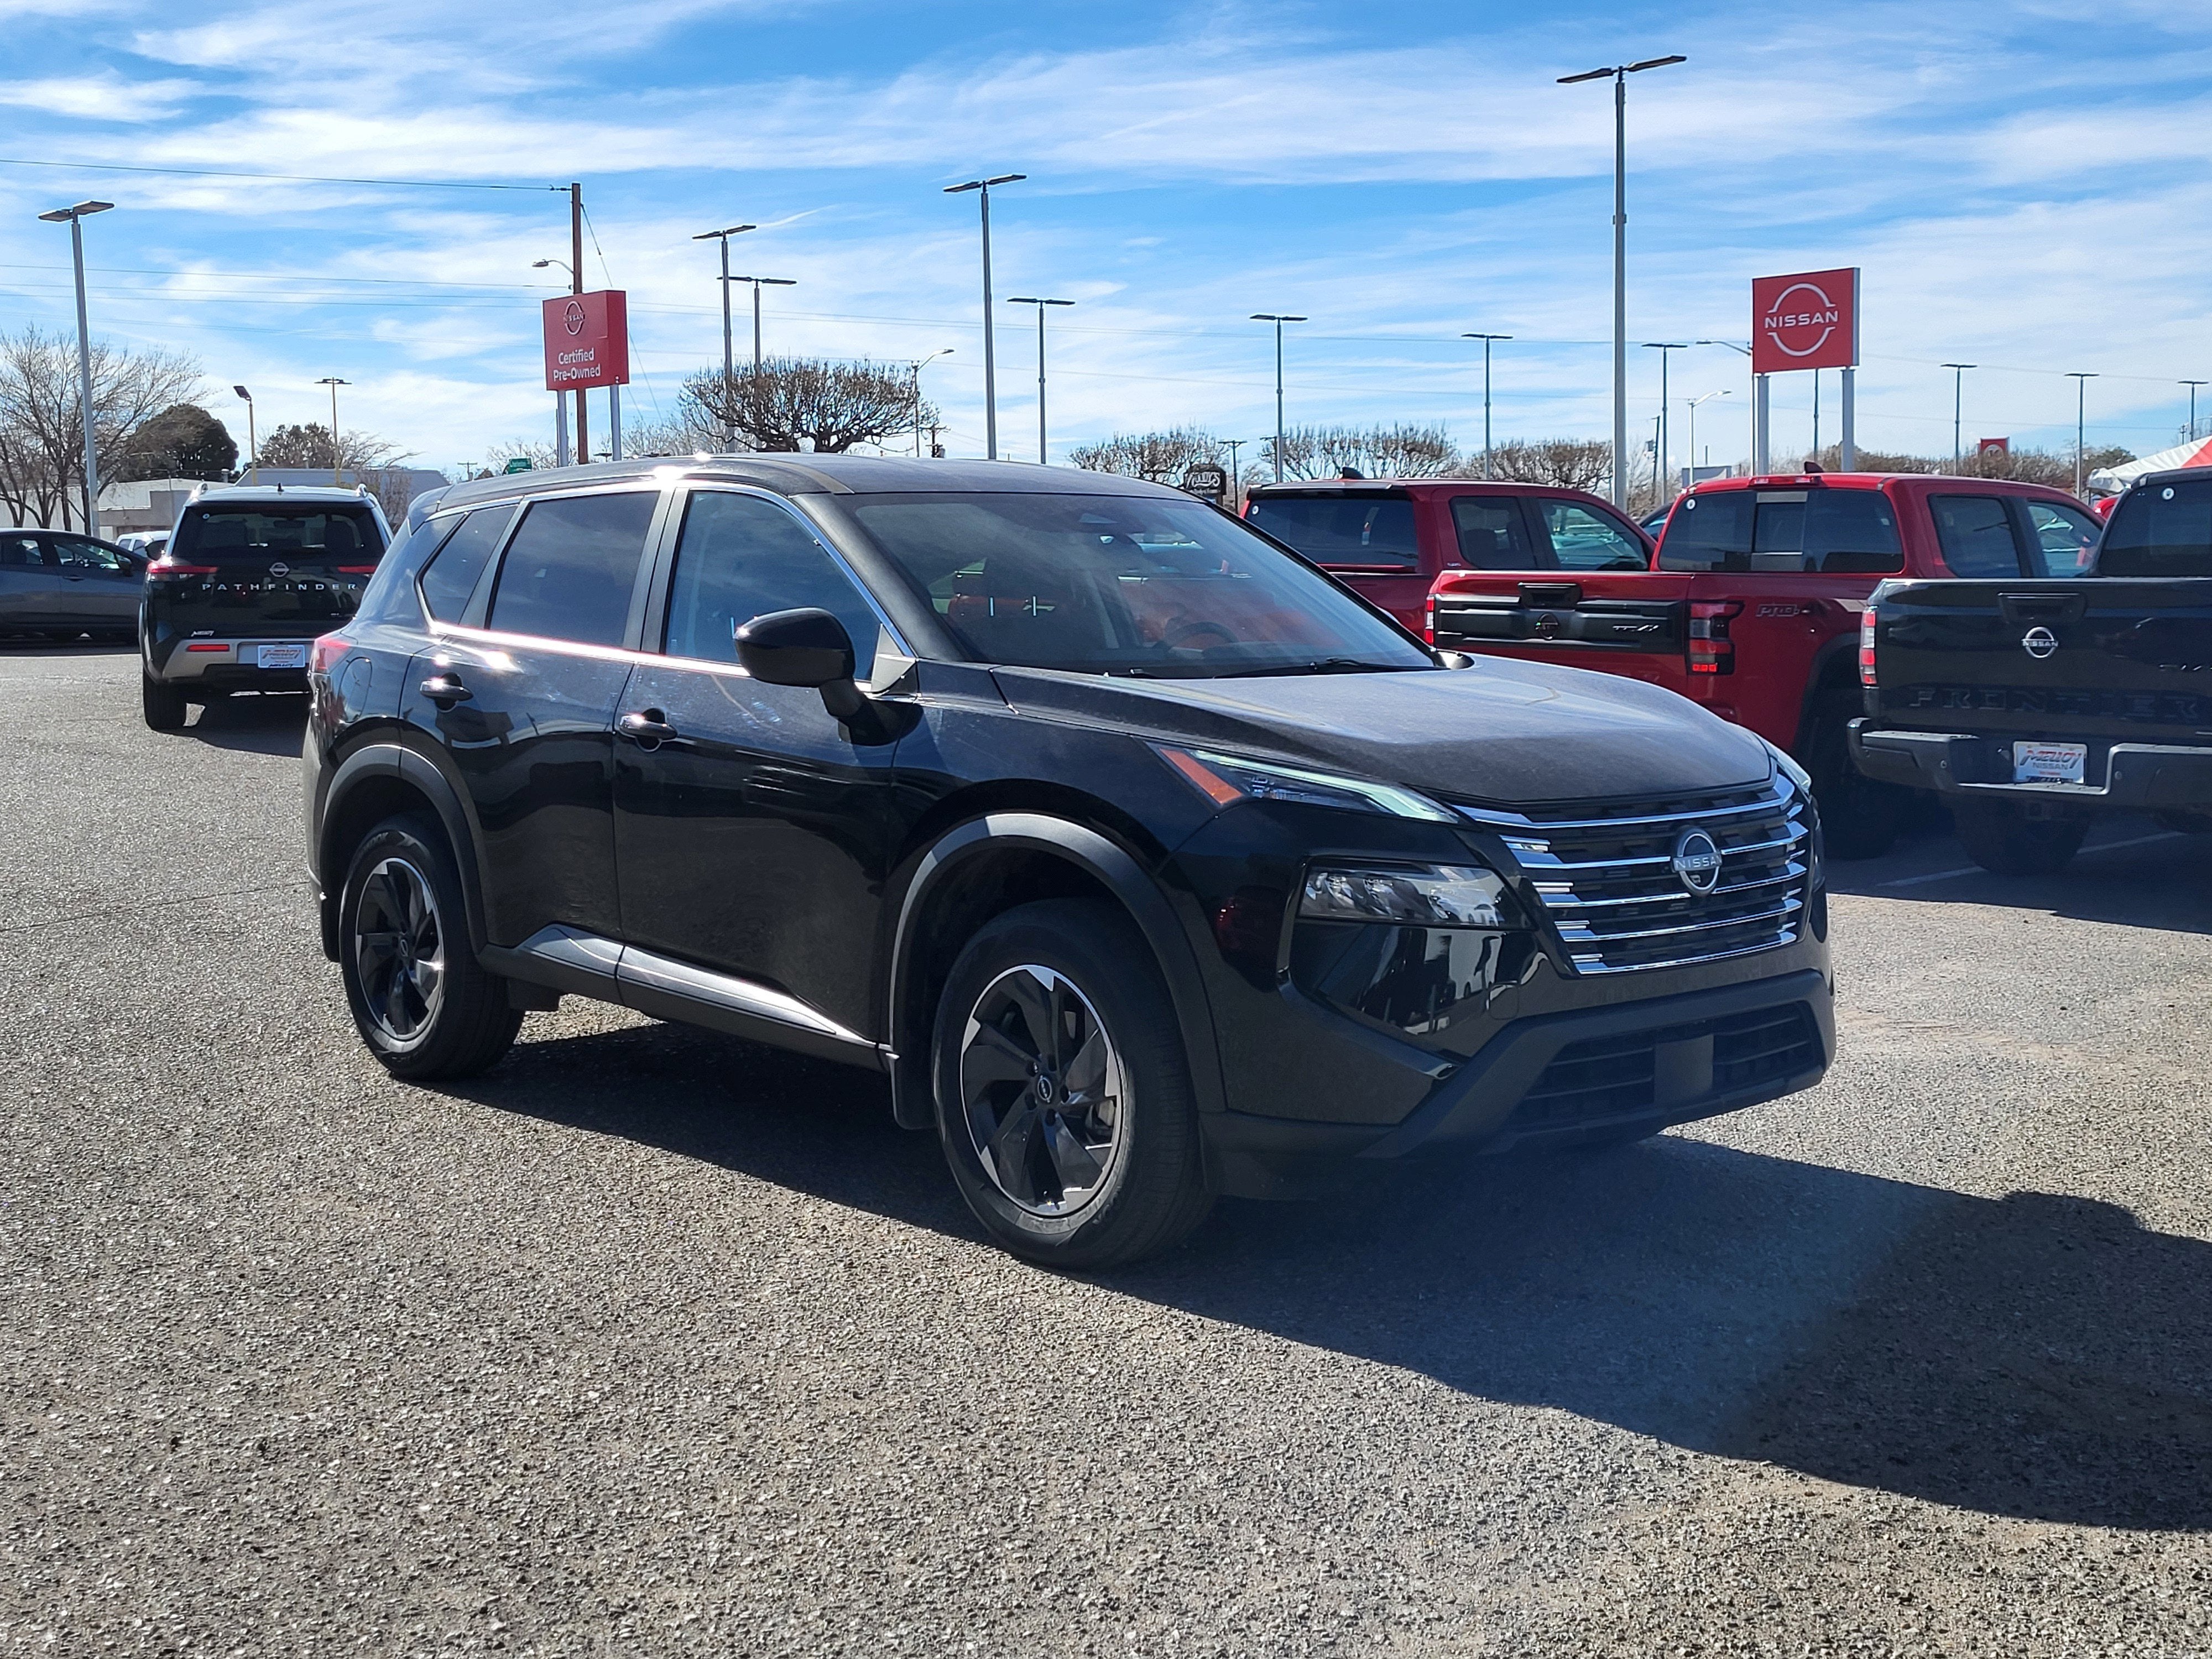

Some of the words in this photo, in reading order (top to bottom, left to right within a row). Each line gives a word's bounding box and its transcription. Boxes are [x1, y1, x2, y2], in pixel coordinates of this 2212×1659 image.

[1765, 310, 1838, 328] NISSAN
[558, 347, 594, 365] Certified
[553, 363, 601, 382] Pre-Owned
[1909, 686, 2198, 718] FRONTIER
[1675, 855, 1722, 869] NISSAN
